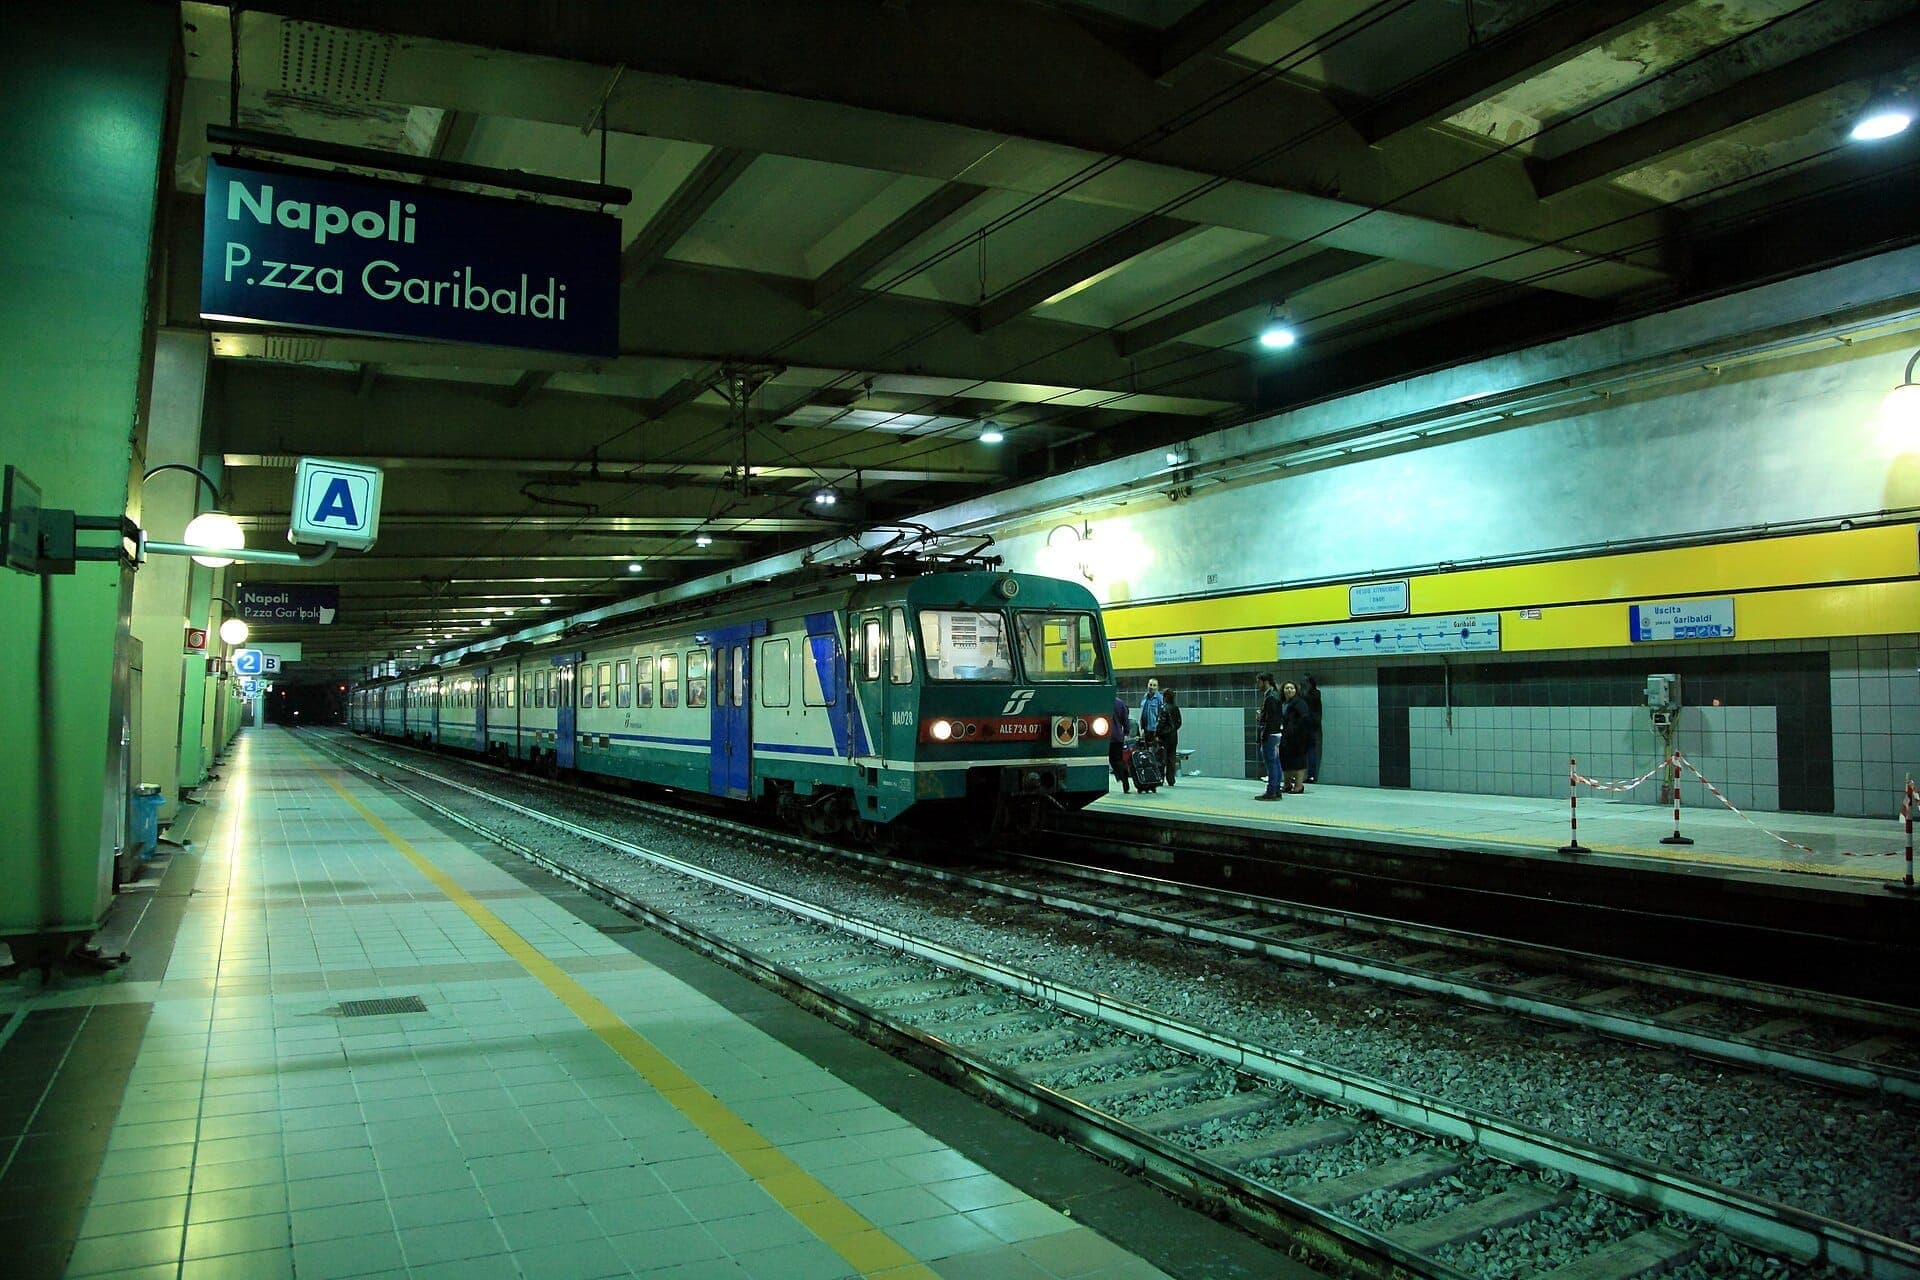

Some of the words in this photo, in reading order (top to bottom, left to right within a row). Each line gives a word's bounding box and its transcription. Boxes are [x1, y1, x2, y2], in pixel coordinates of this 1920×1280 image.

[227, 181, 417, 245] Napoli
[225, 242, 343, 295] P.zza
[361, 260, 567, 321] Garibaldi
[313, 478, 359, 526] A
[244, 593, 289, 606] Napoli
[275, 607, 320, 619] Garbal
[1654, 606, 1682, 615] Uscita
[1673, 615, 1712, 624] Garibaldi
[243, 655, 255, 670] 2
[266, 658, 276, 669] B
